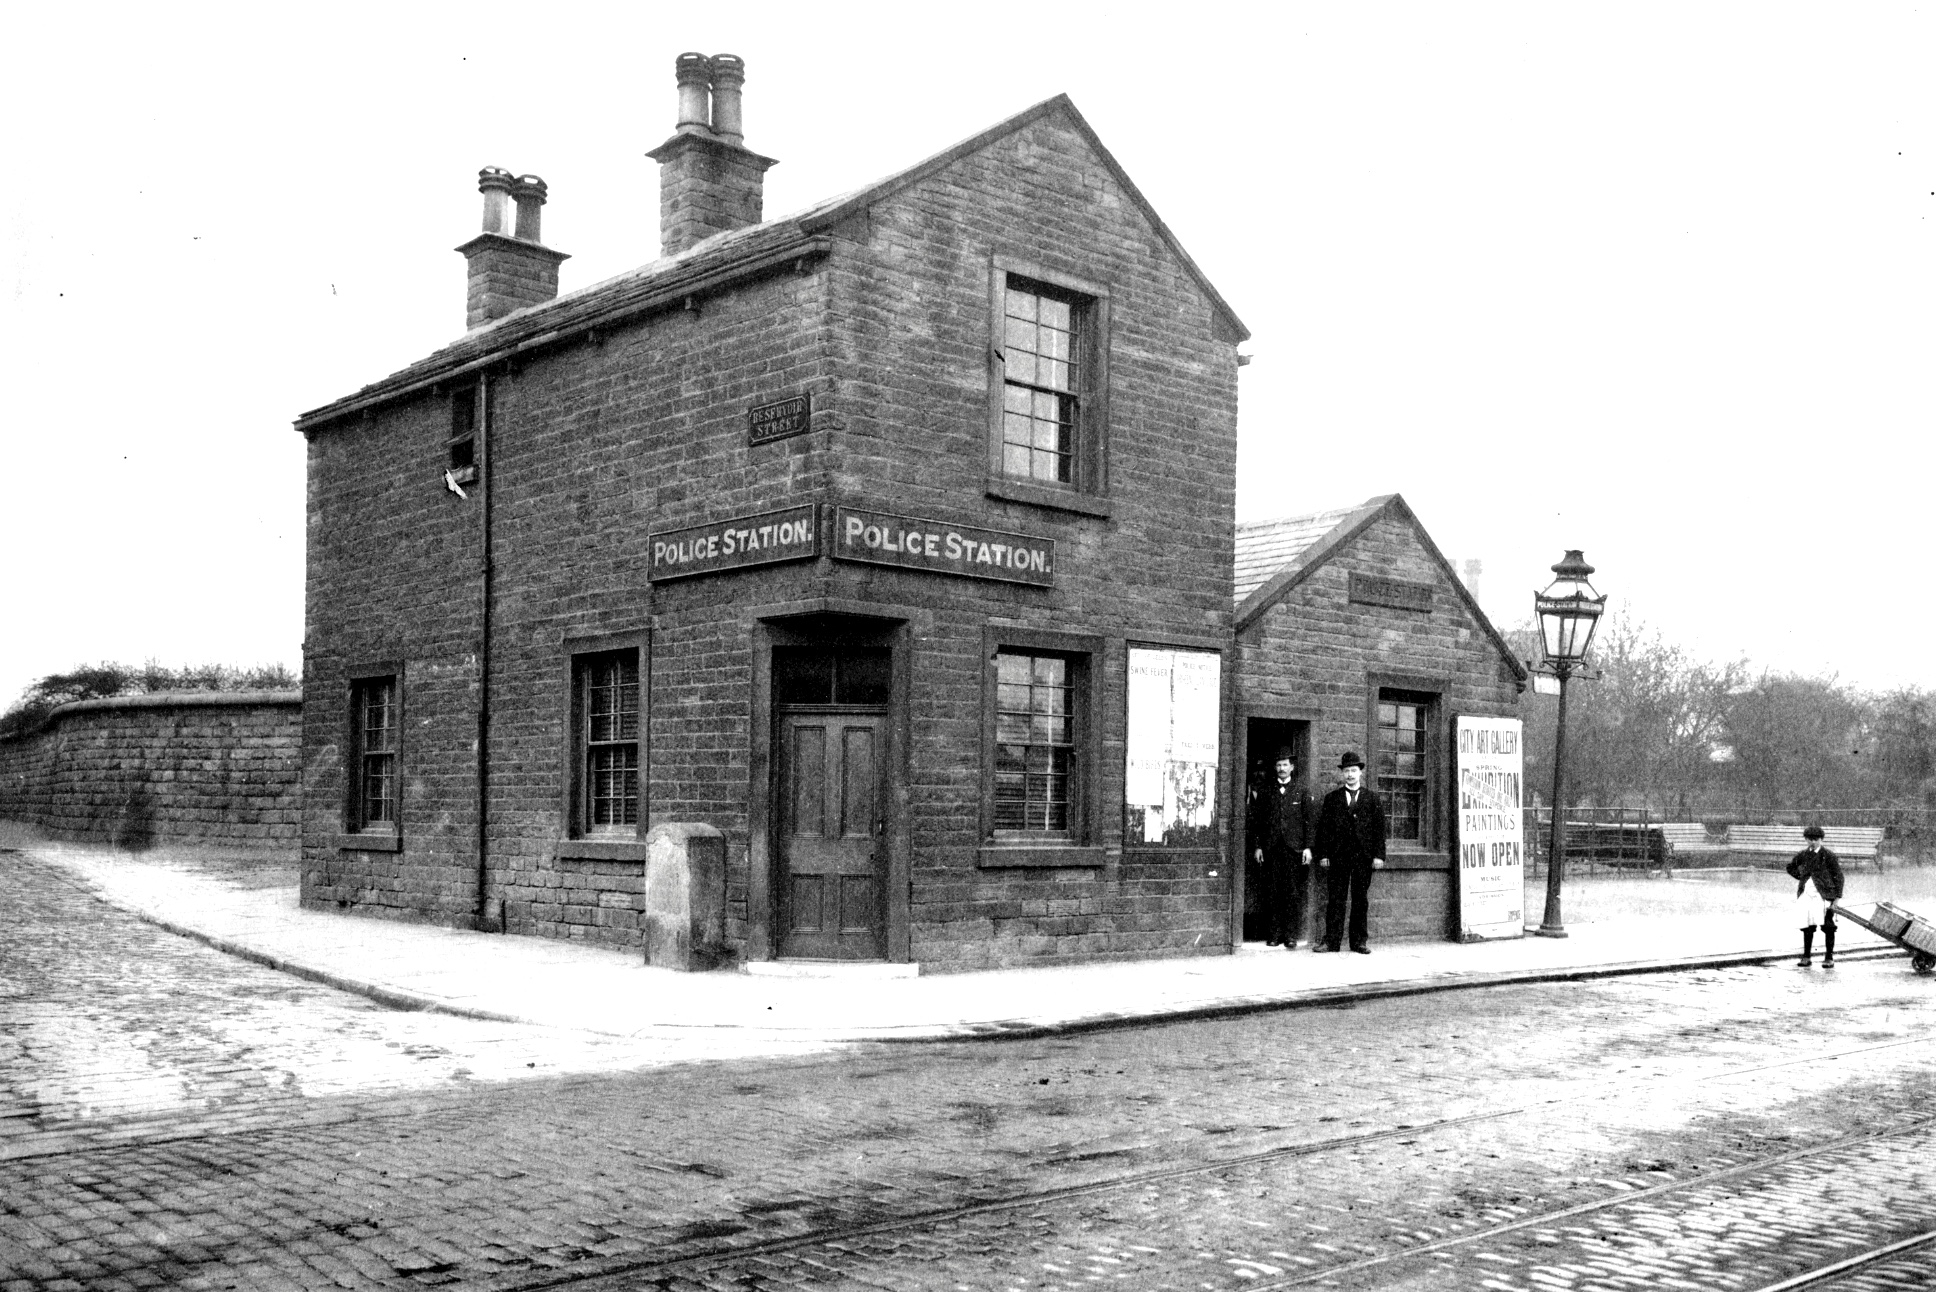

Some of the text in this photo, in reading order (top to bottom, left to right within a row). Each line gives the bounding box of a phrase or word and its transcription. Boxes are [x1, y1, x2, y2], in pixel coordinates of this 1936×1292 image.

[753, 401, 802, 423] RESERVOIR
[757, 416, 799, 437] STREET
[845, 516, 939, 558] POLICE
[654, 535, 719, 567] POLICE
[1130, 665, 1168, 677] SWINE FEVER
[1460, 729, 1519, 754] CITY ART GALLERY
[1466, 814, 1515, 831] PAINTINGS
[1462, 841, 1519, 869] NOW OPEN
